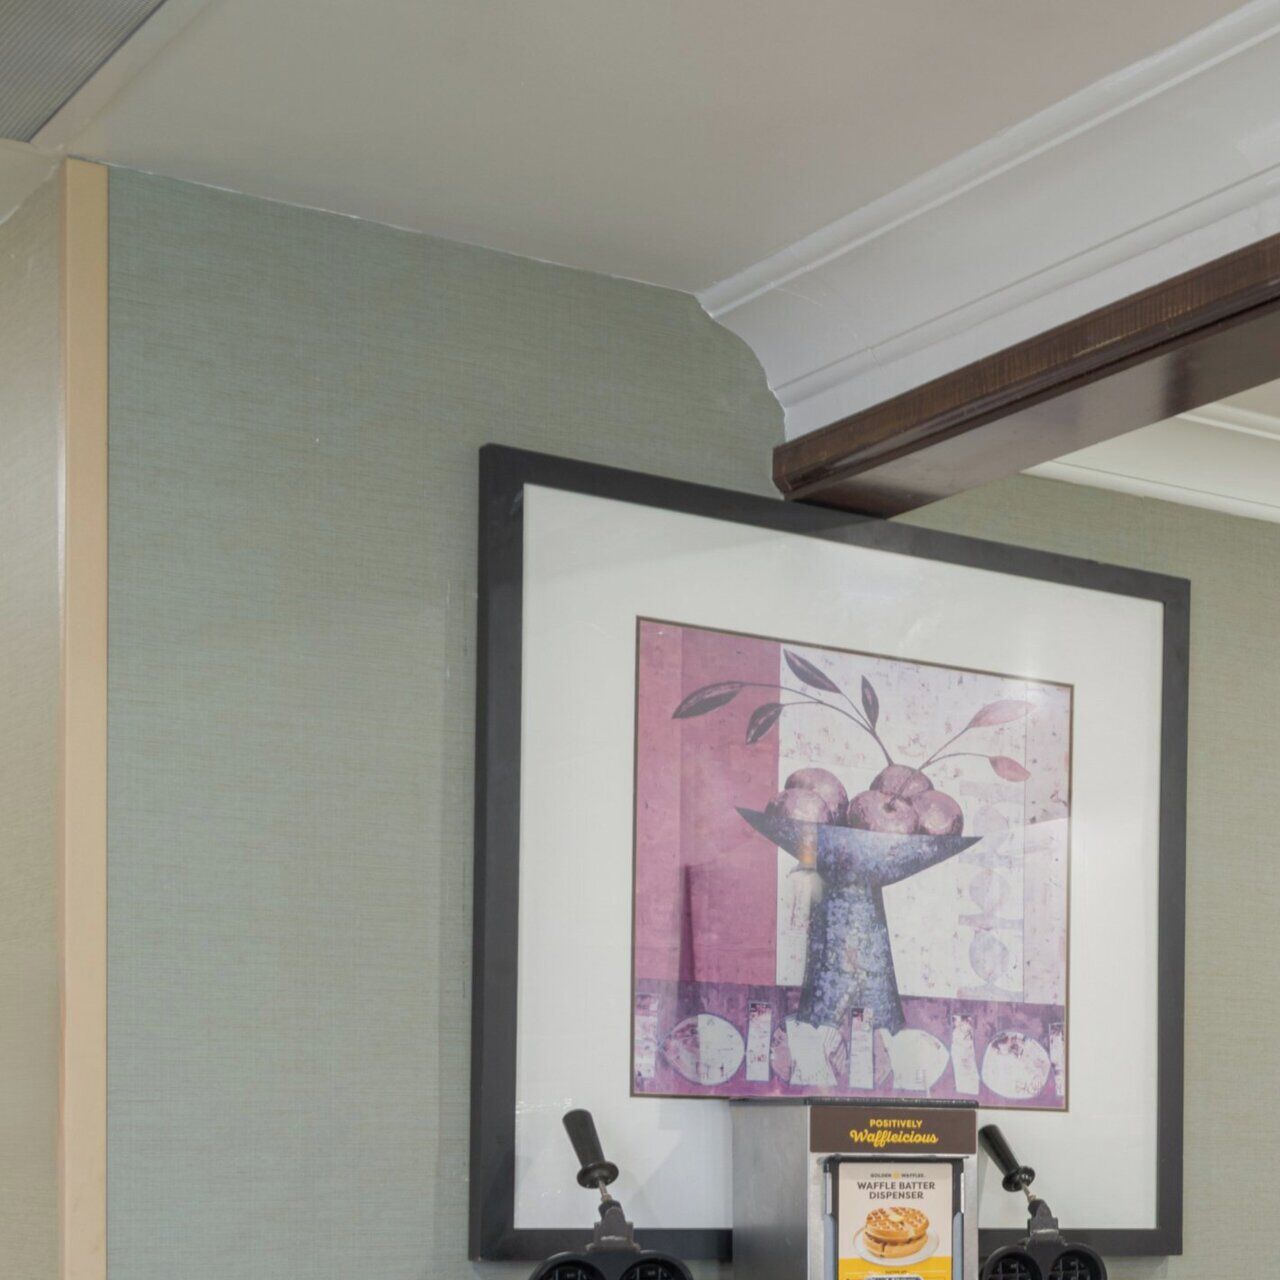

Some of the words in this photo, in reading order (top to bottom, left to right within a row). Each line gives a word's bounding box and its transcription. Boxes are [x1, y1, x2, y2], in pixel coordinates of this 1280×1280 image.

[869, 1119, 923, 1129] POSITIVELY
[857, 1181, 896, 1190] WAFFLE
[898, 1181, 935, 1190] BATTER
[869, 1190, 924, 1200] DISPENSER
